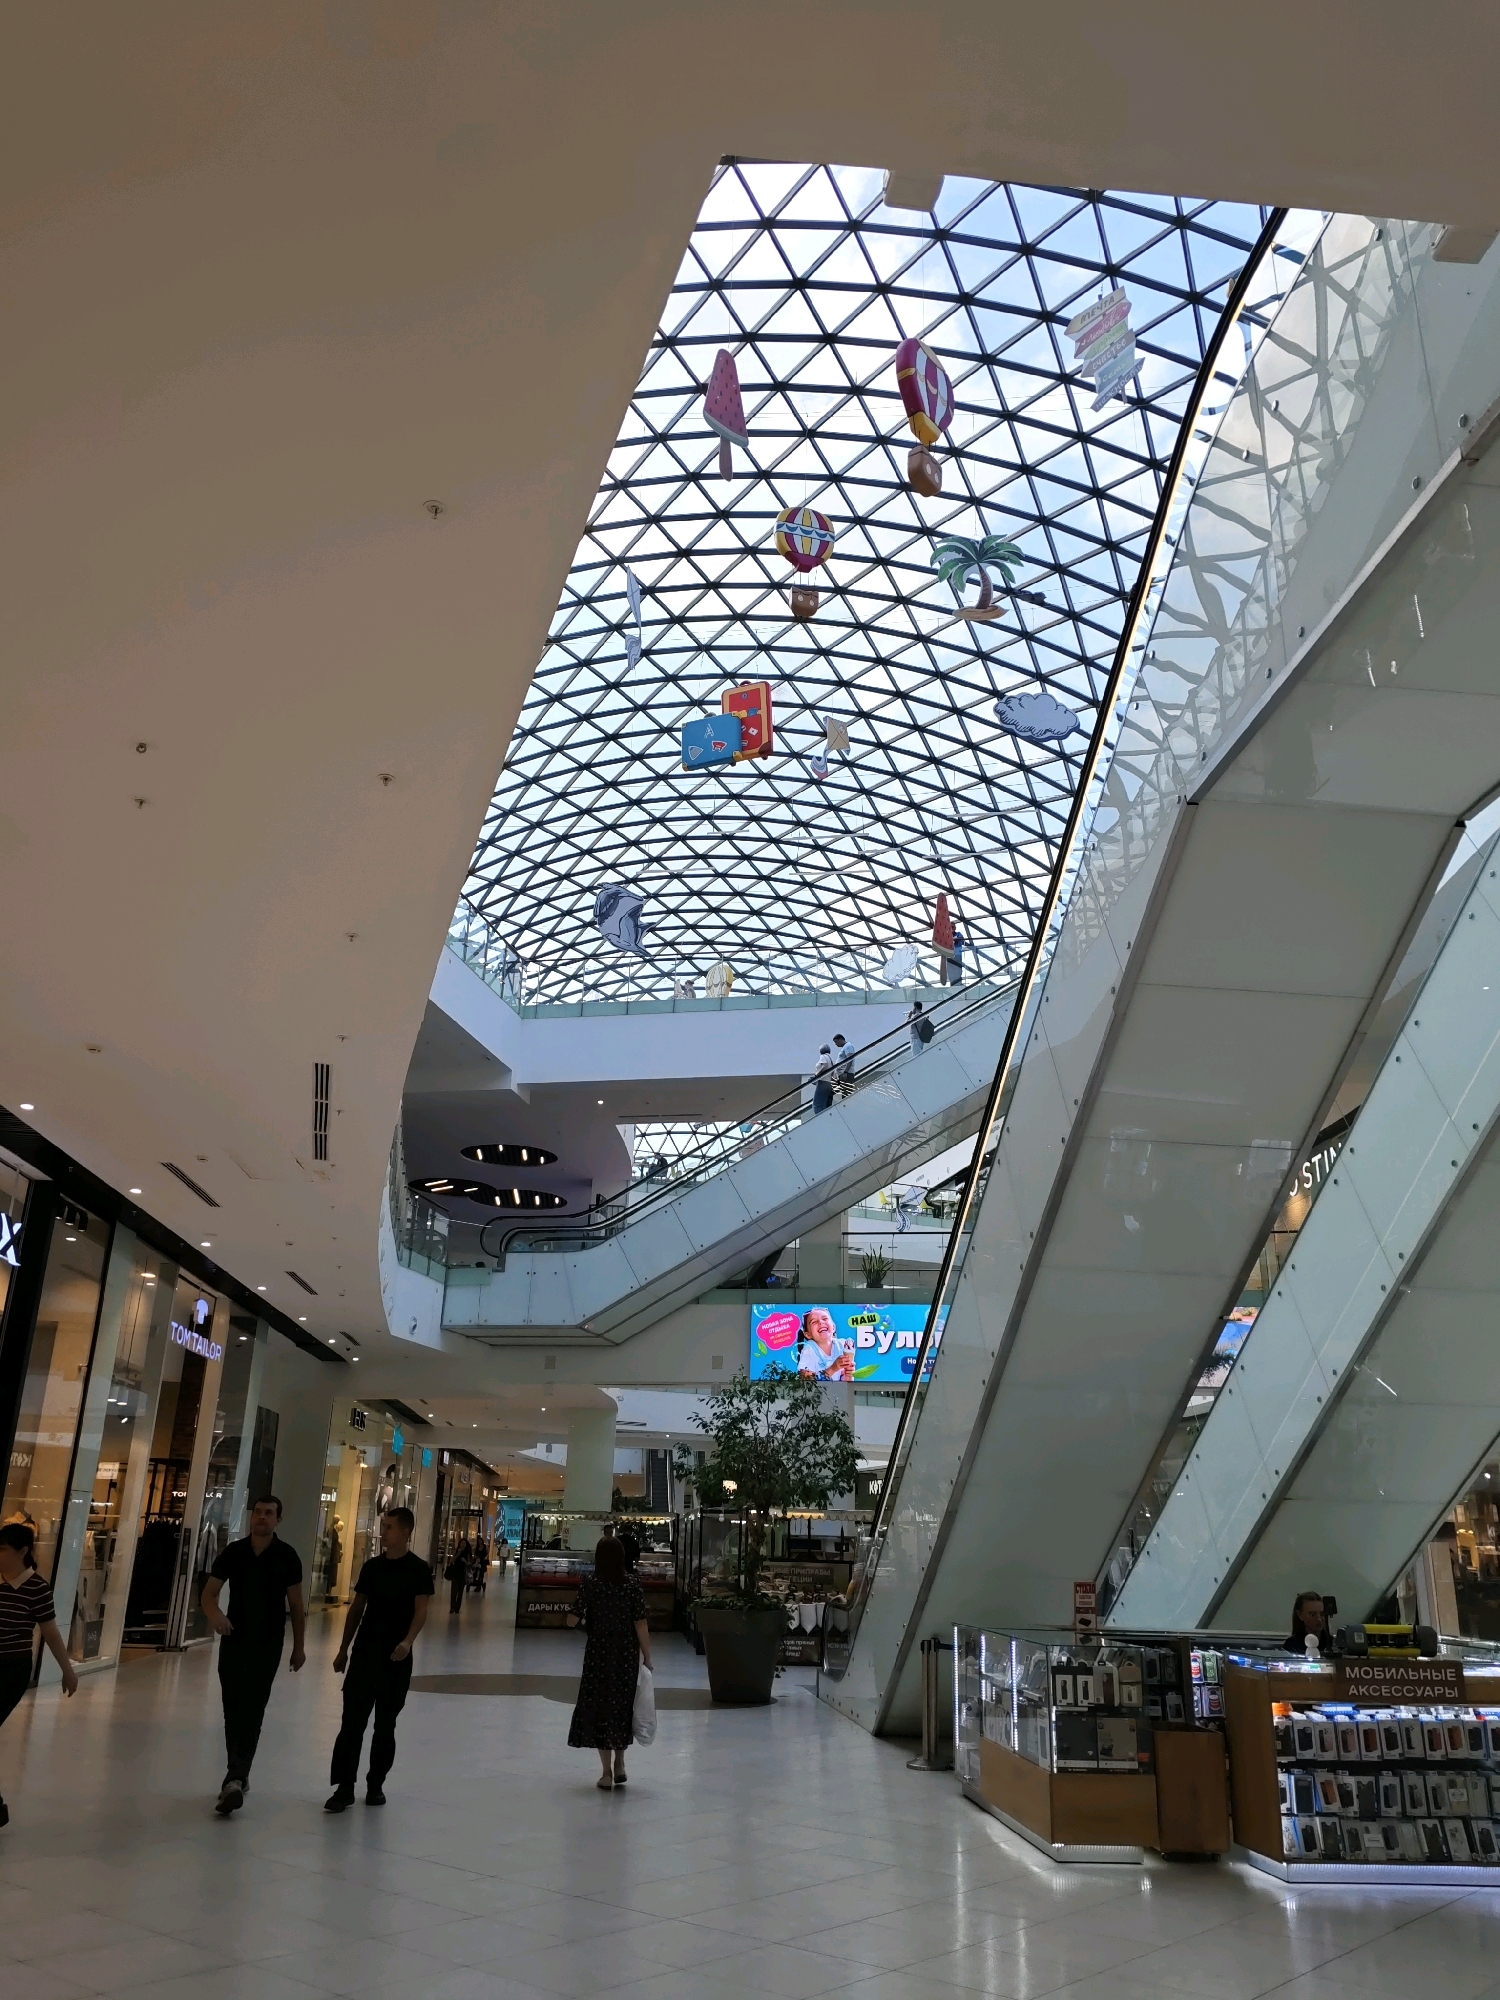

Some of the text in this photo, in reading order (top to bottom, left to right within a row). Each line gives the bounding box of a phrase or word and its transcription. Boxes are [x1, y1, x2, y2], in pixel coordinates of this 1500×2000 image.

[761, 1315, 794, 1330] НОВАЯ ЗОНА
[851, 1314, 876, 1326] НАШ
[768, 1323, 790, 1334] ОТДЫХА
[170, 1321, 222, 1362] TOM TAILOR
[790, 1567, 831, 1576] ПРИПРАВЫ
[528, 1603, 553, 1612] ДАРЫ
[1345, 1666, 1457, 1681] МОБИЛЬНЫЕ
[1348, 1685, 1459, 1698] АКСЕССУАРЫ
